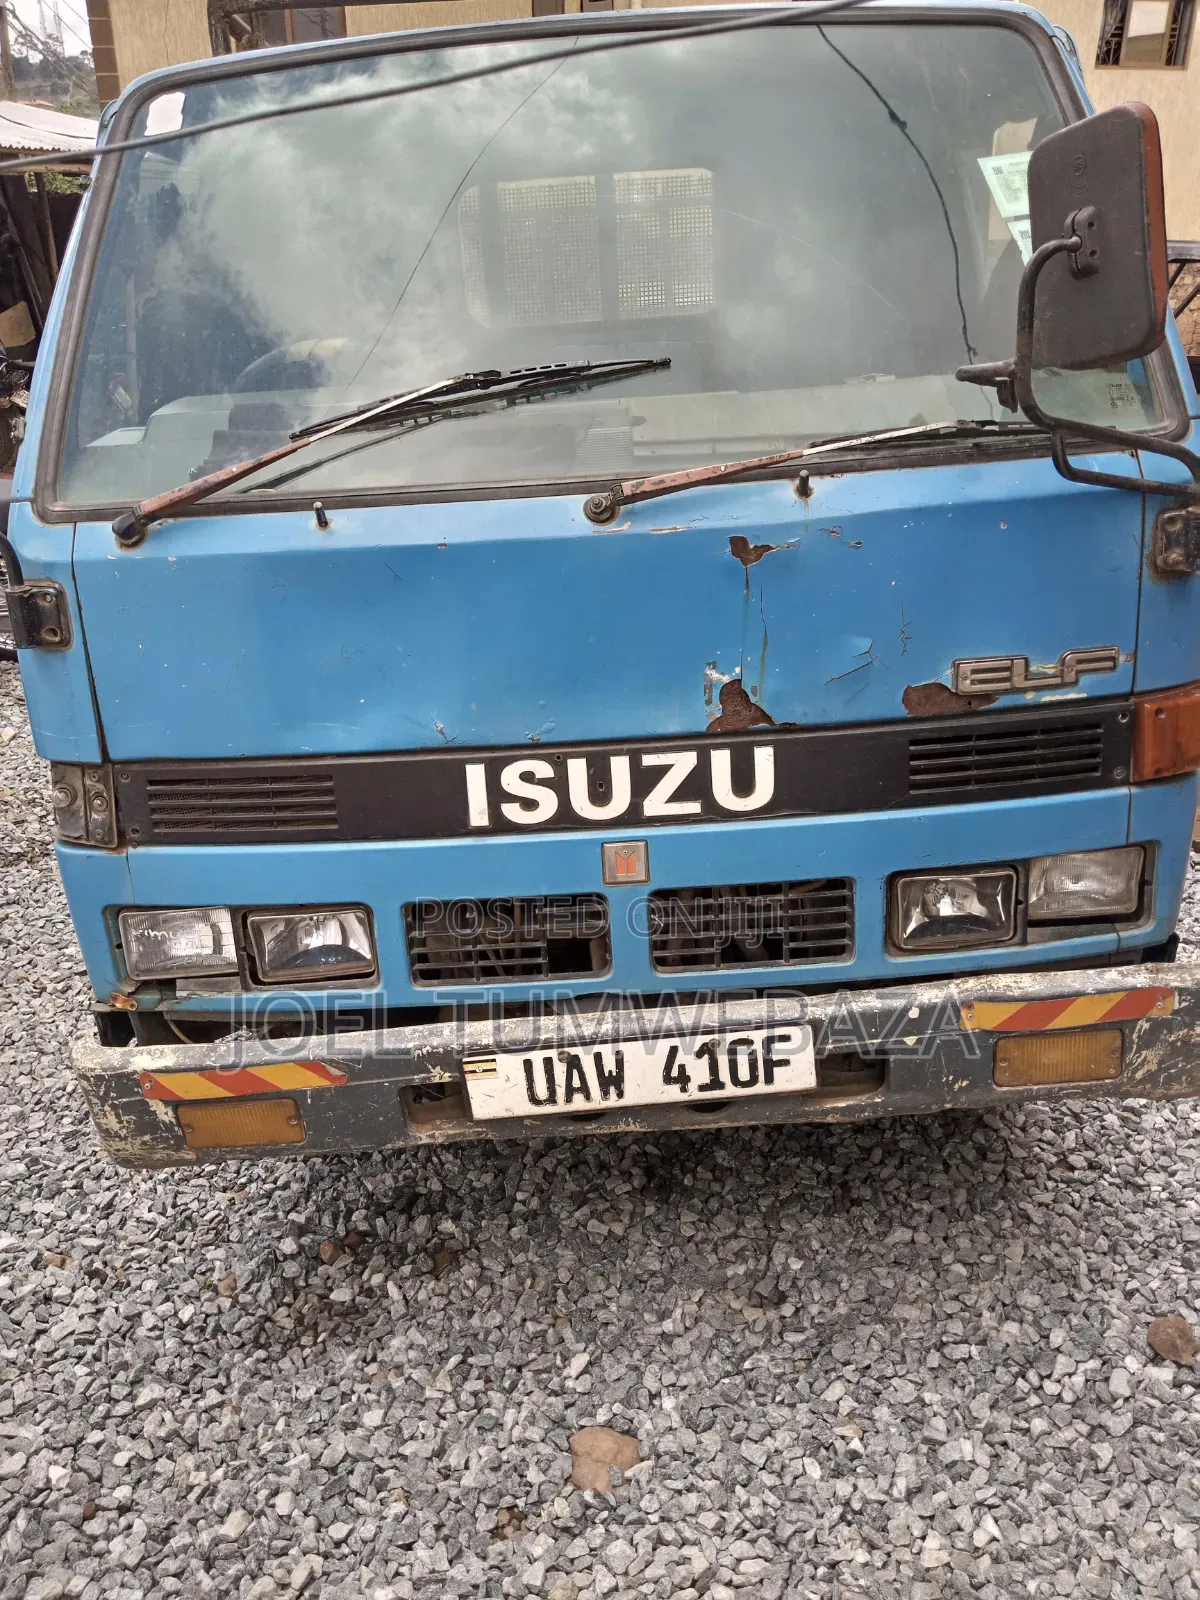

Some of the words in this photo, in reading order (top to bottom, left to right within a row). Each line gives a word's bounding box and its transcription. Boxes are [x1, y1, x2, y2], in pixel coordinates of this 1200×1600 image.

[953, 645, 1119, 695] ELF
[465, 745, 775, 827] ISUZU
[523, 1050, 625, 1108] UAW
[662, 1033, 793, 1094] 410F
